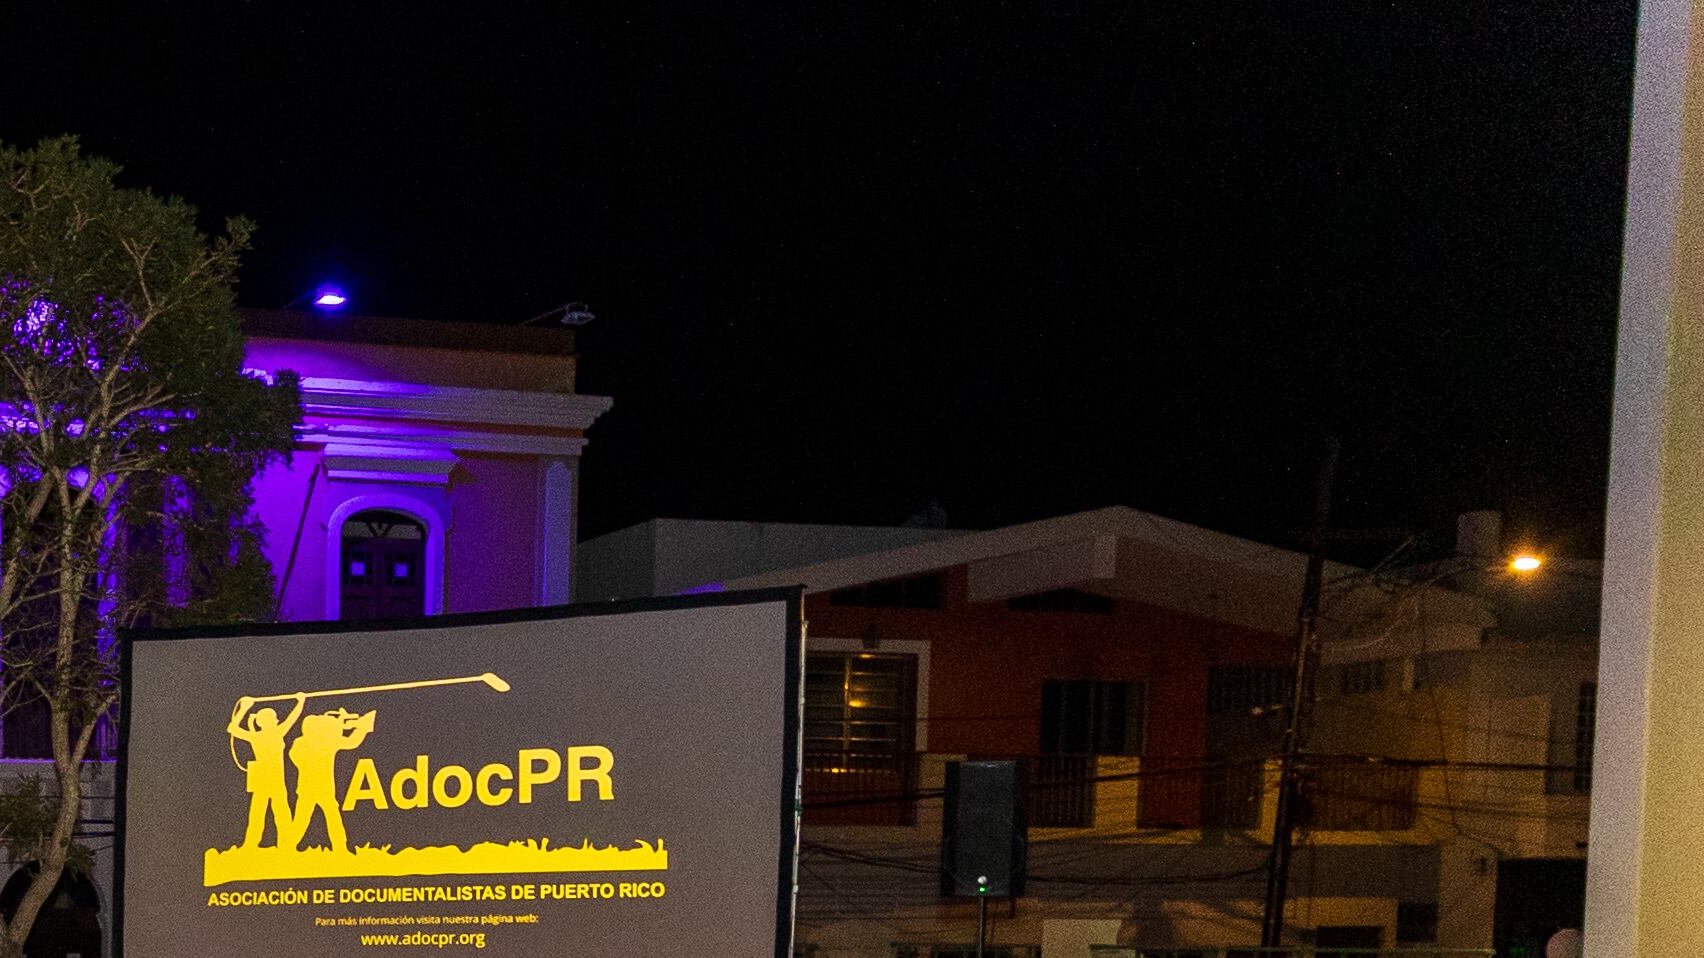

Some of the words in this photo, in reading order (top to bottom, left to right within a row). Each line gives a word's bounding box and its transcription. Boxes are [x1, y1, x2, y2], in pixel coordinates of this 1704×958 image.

[343, 745, 615, 811] AdocPR
[208, 887, 308, 907] ASOCIACIÓN
[312, 889, 335, 905] DE
[339, 886, 507, 904] DOCUMENTALISTAS
[511, 884, 536, 900] DE
[540, 883, 615, 900] PUERTO
[619, 881, 666, 898] RICO
[315, 916, 336, 927] Para
[337, 915, 357, 926] más
[359, 915, 415, 926] información
[416, 914, 441, 925] visita
[442, 914, 479, 924] nuestra
[481, 913, 514, 926] página
[515, 913, 539, 924] web:
[361, 930, 486, 949] www.adocpr.org
